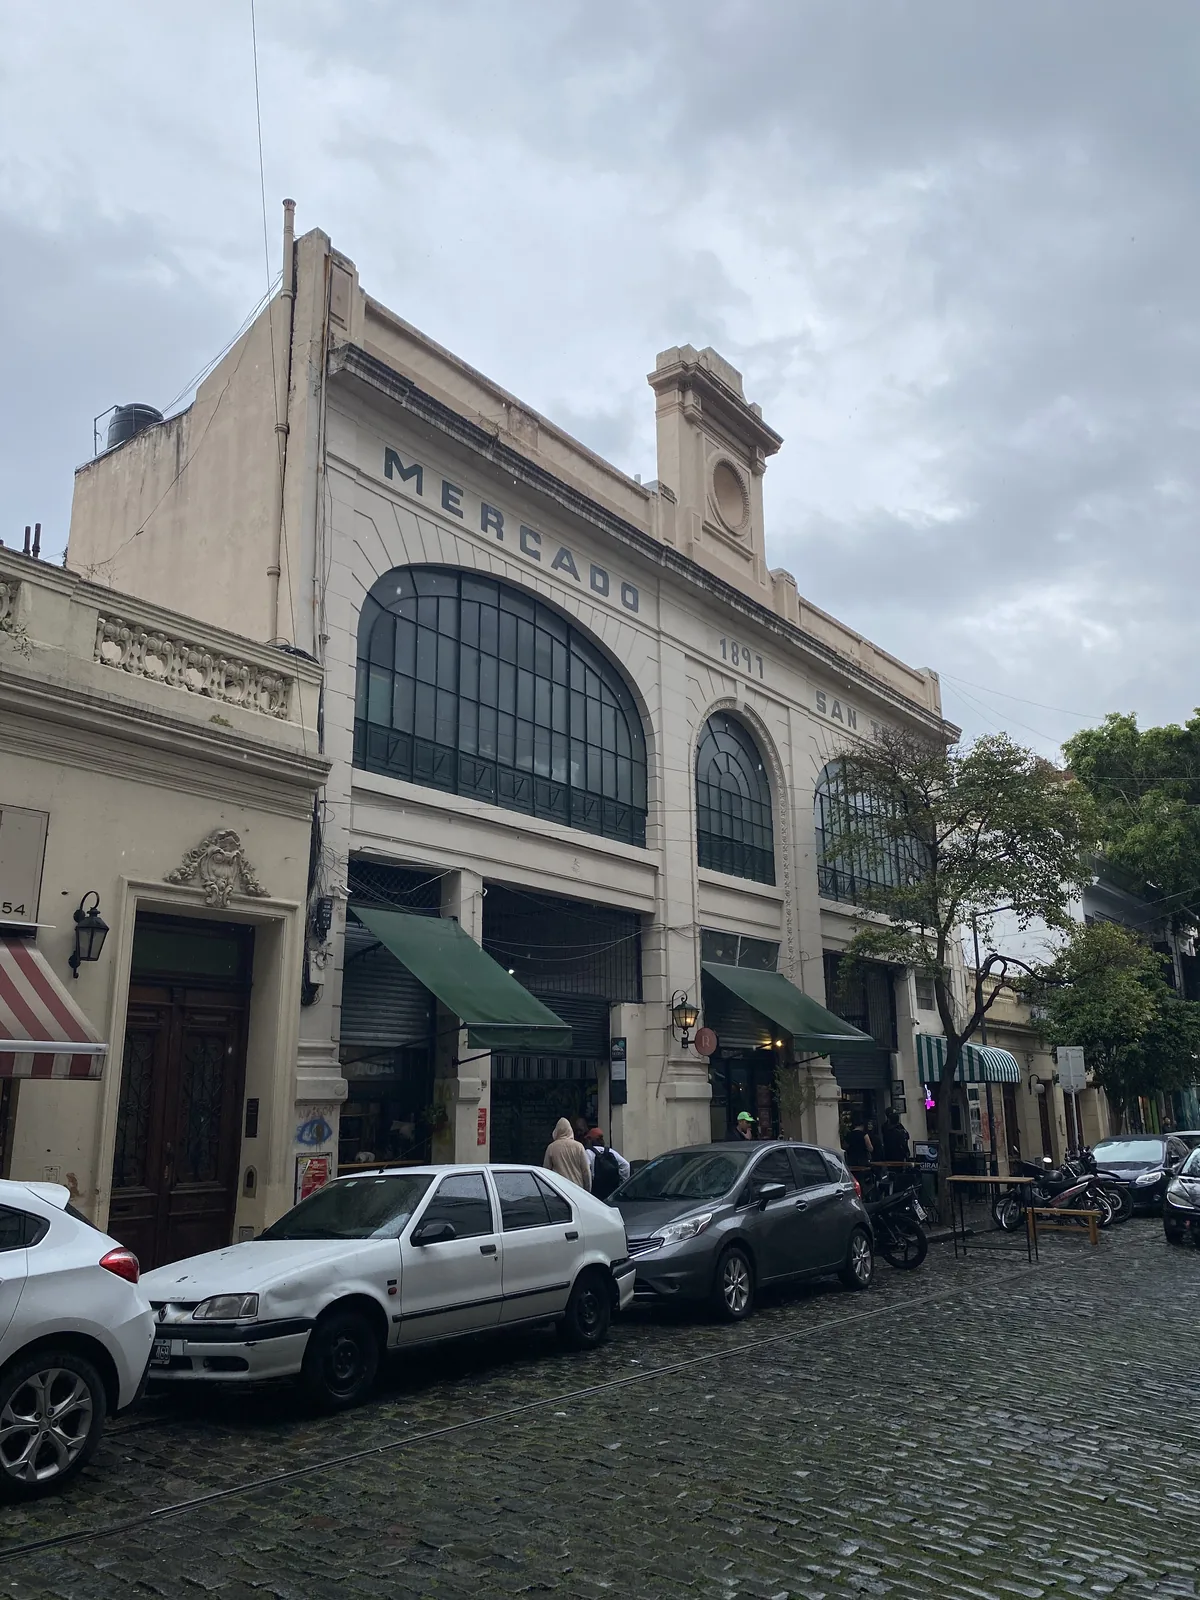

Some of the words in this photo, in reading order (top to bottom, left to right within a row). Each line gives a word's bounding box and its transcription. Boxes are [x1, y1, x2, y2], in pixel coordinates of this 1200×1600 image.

[384, 446, 639, 613] MERCADO
[719, 638, 763, 679] 1897
[816, 690, 857, 730] SAN
[1, 901, 26, 916] 54
